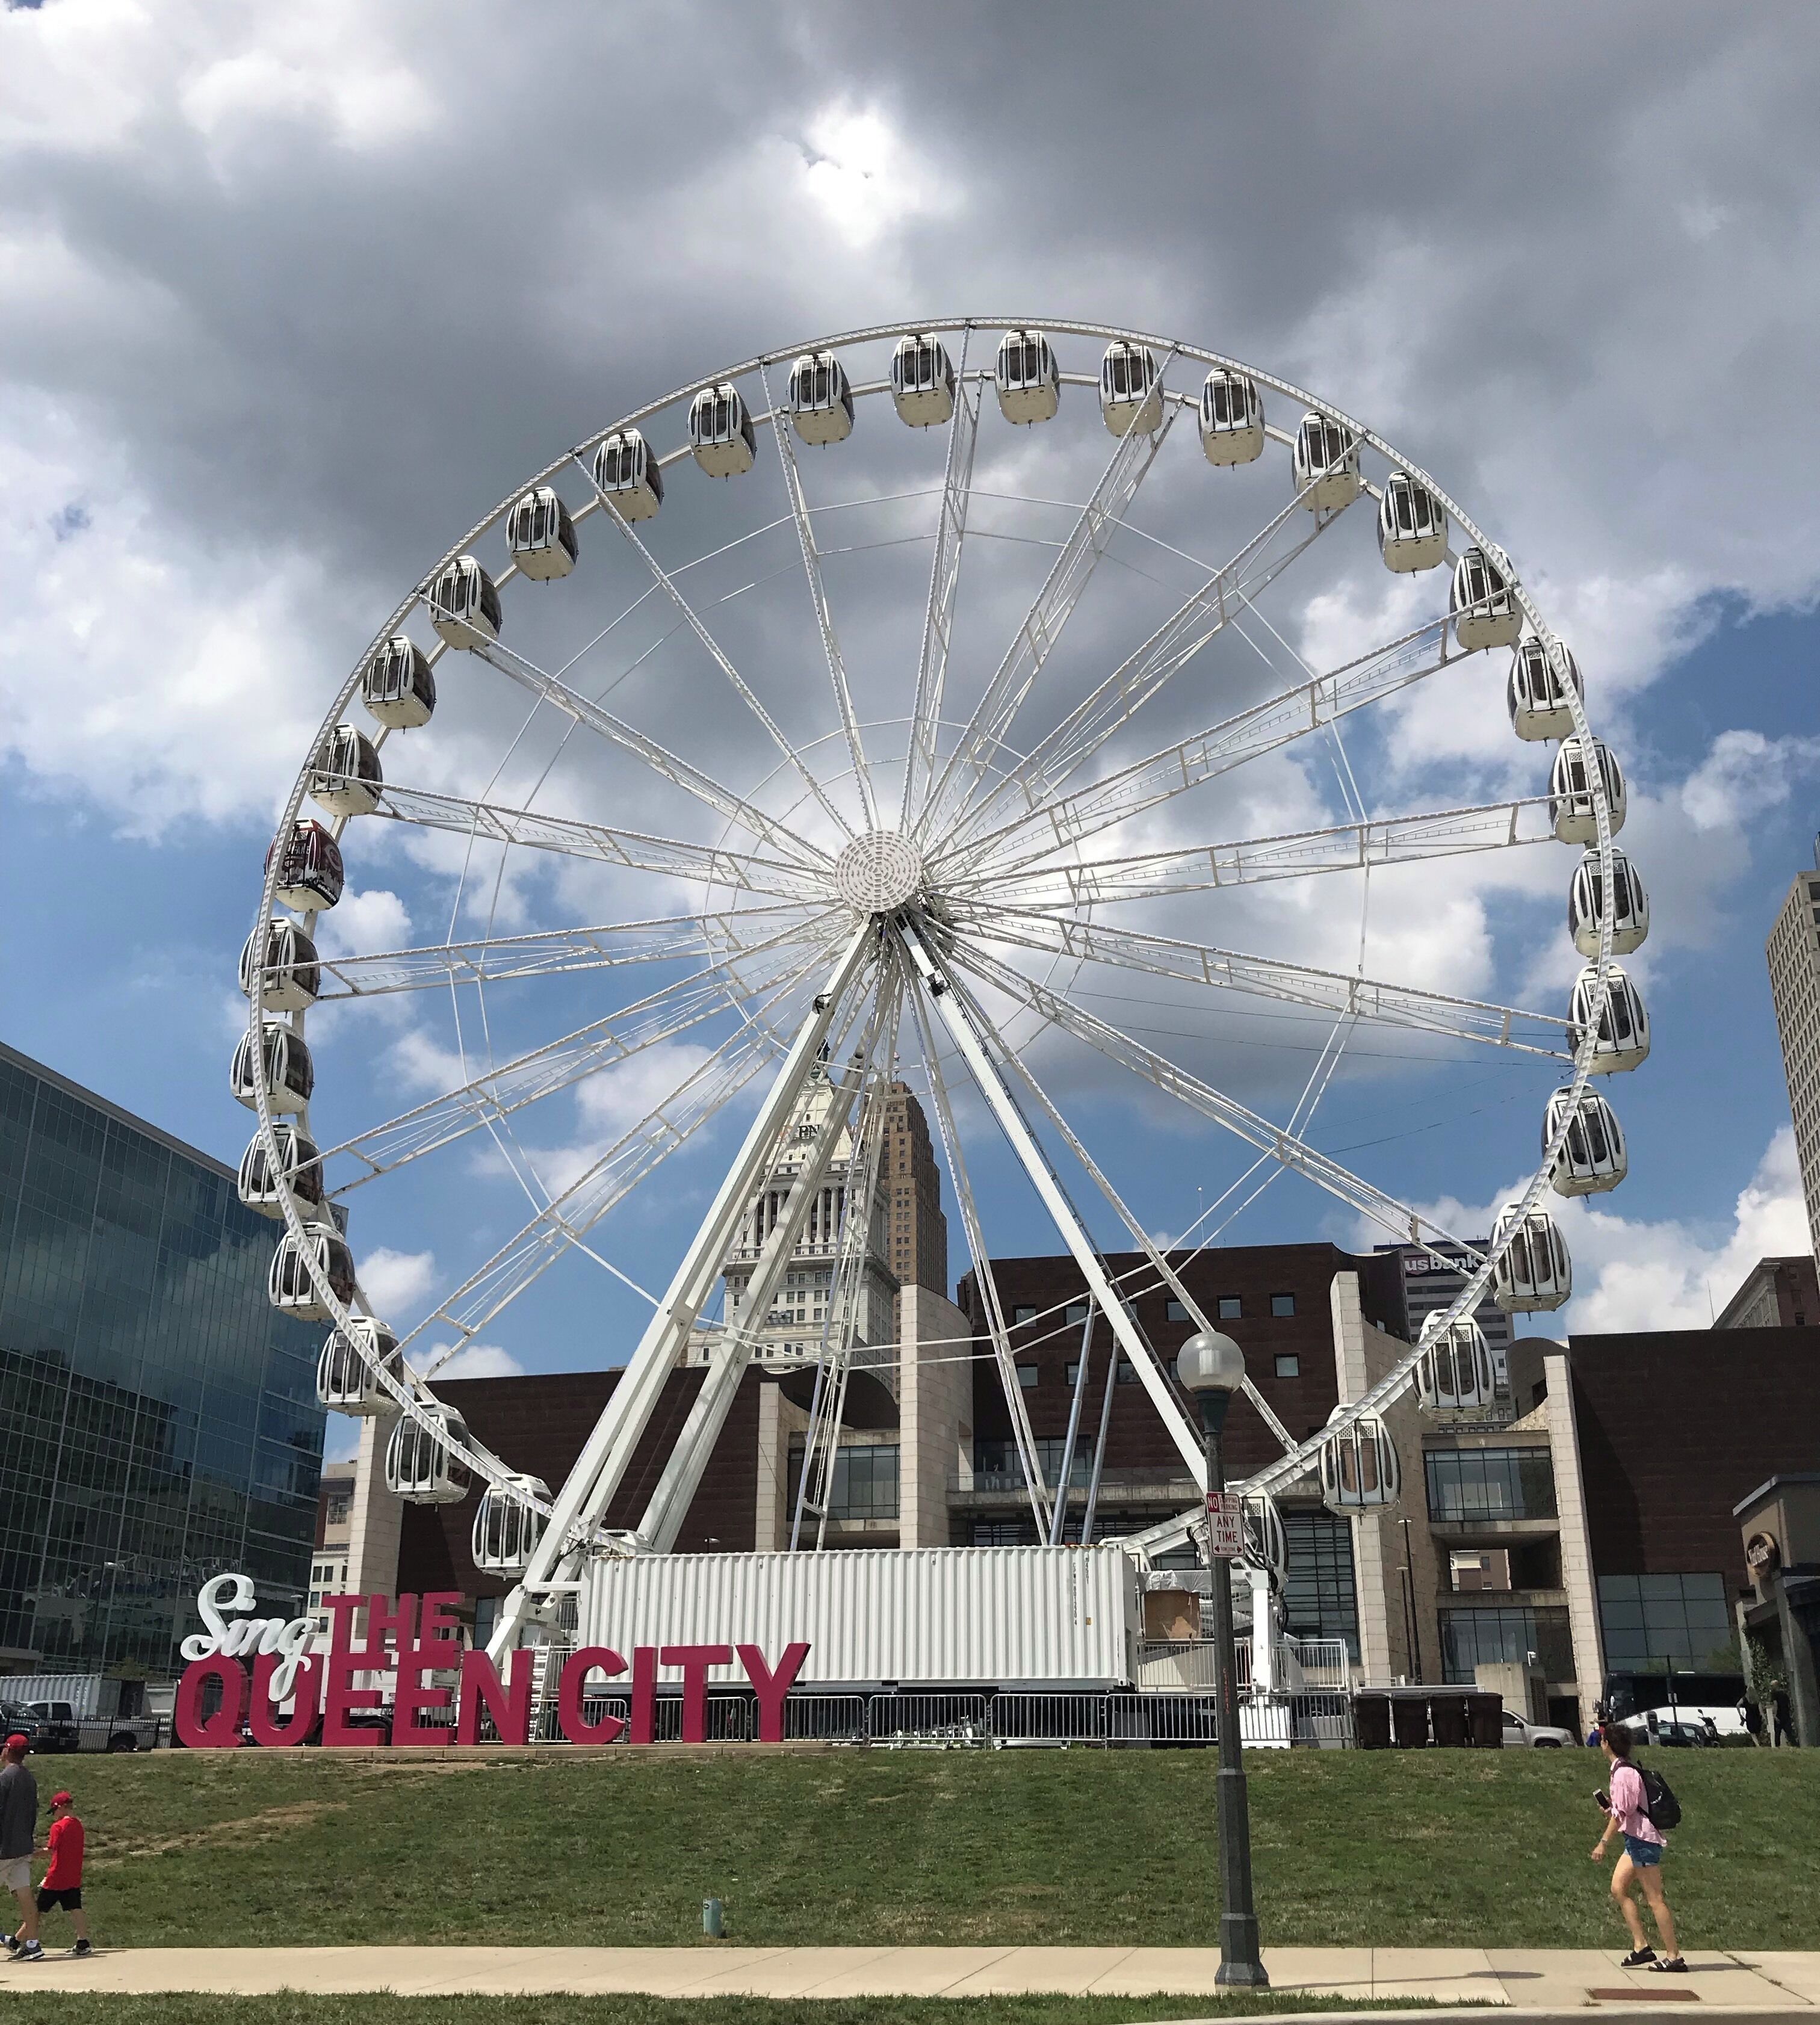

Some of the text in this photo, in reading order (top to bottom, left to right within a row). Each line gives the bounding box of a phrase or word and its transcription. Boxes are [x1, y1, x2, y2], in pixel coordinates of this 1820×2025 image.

[798, 1125, 820, 1137] PN
[1207, 1496, 1219, 1509] NO
[1216, 1516, 1235, 1528] ANY
[1216, 1531, 1238, 1543] TIME
[322, 1592, 465, 1651] THE
[181, 1573, 320, 1702] Sing
[175, 1643, 811, 1747] QUEEN CITY
